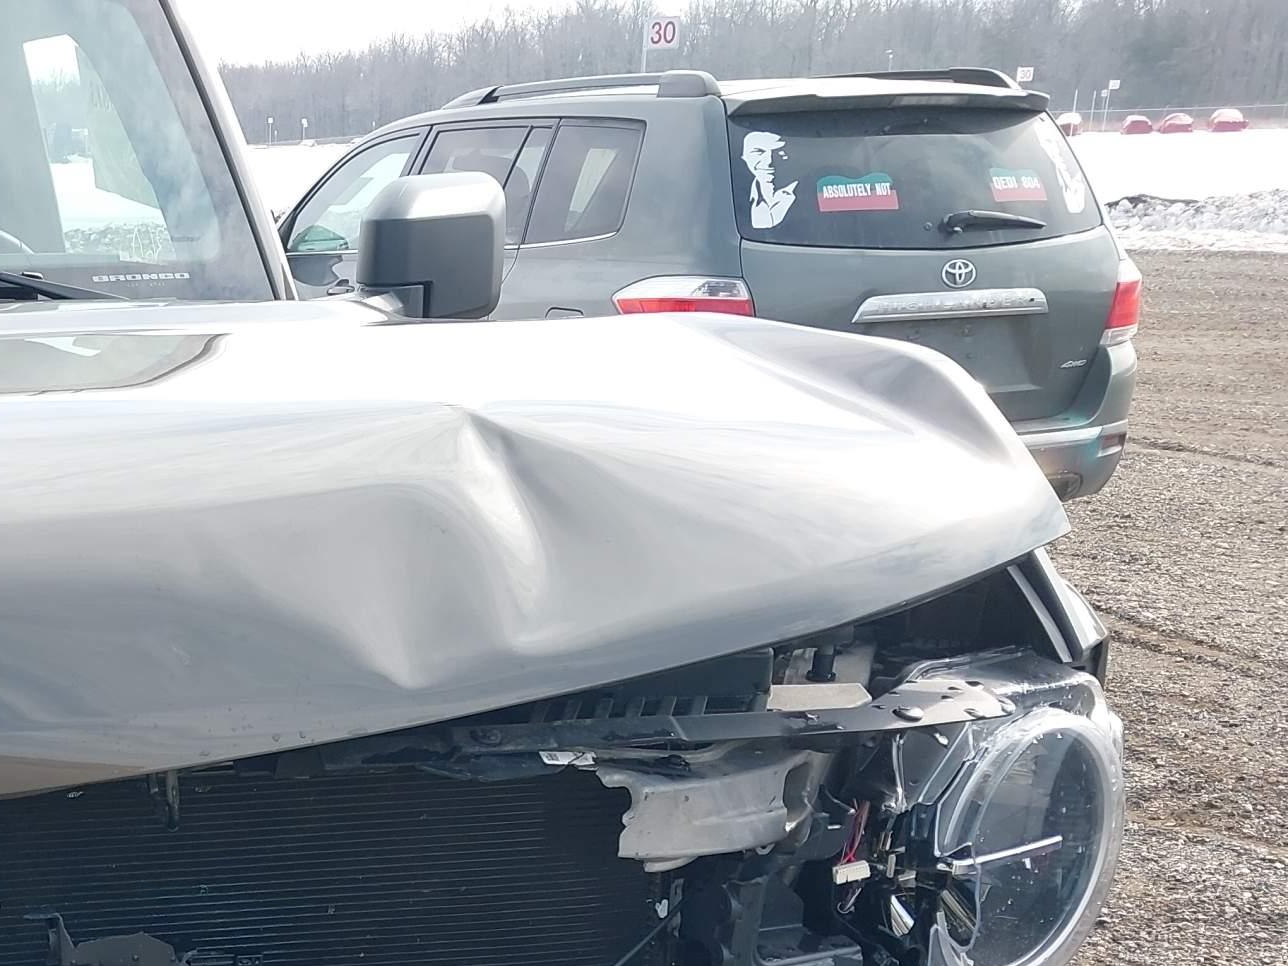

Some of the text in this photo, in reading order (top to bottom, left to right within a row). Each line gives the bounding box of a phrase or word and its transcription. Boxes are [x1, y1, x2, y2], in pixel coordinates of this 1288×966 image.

[651, 21, 675, 44] 30
[823, 182, 890, 198] ABSOLUTELY NOT
[92, 272, 190, 282] BRONCO
